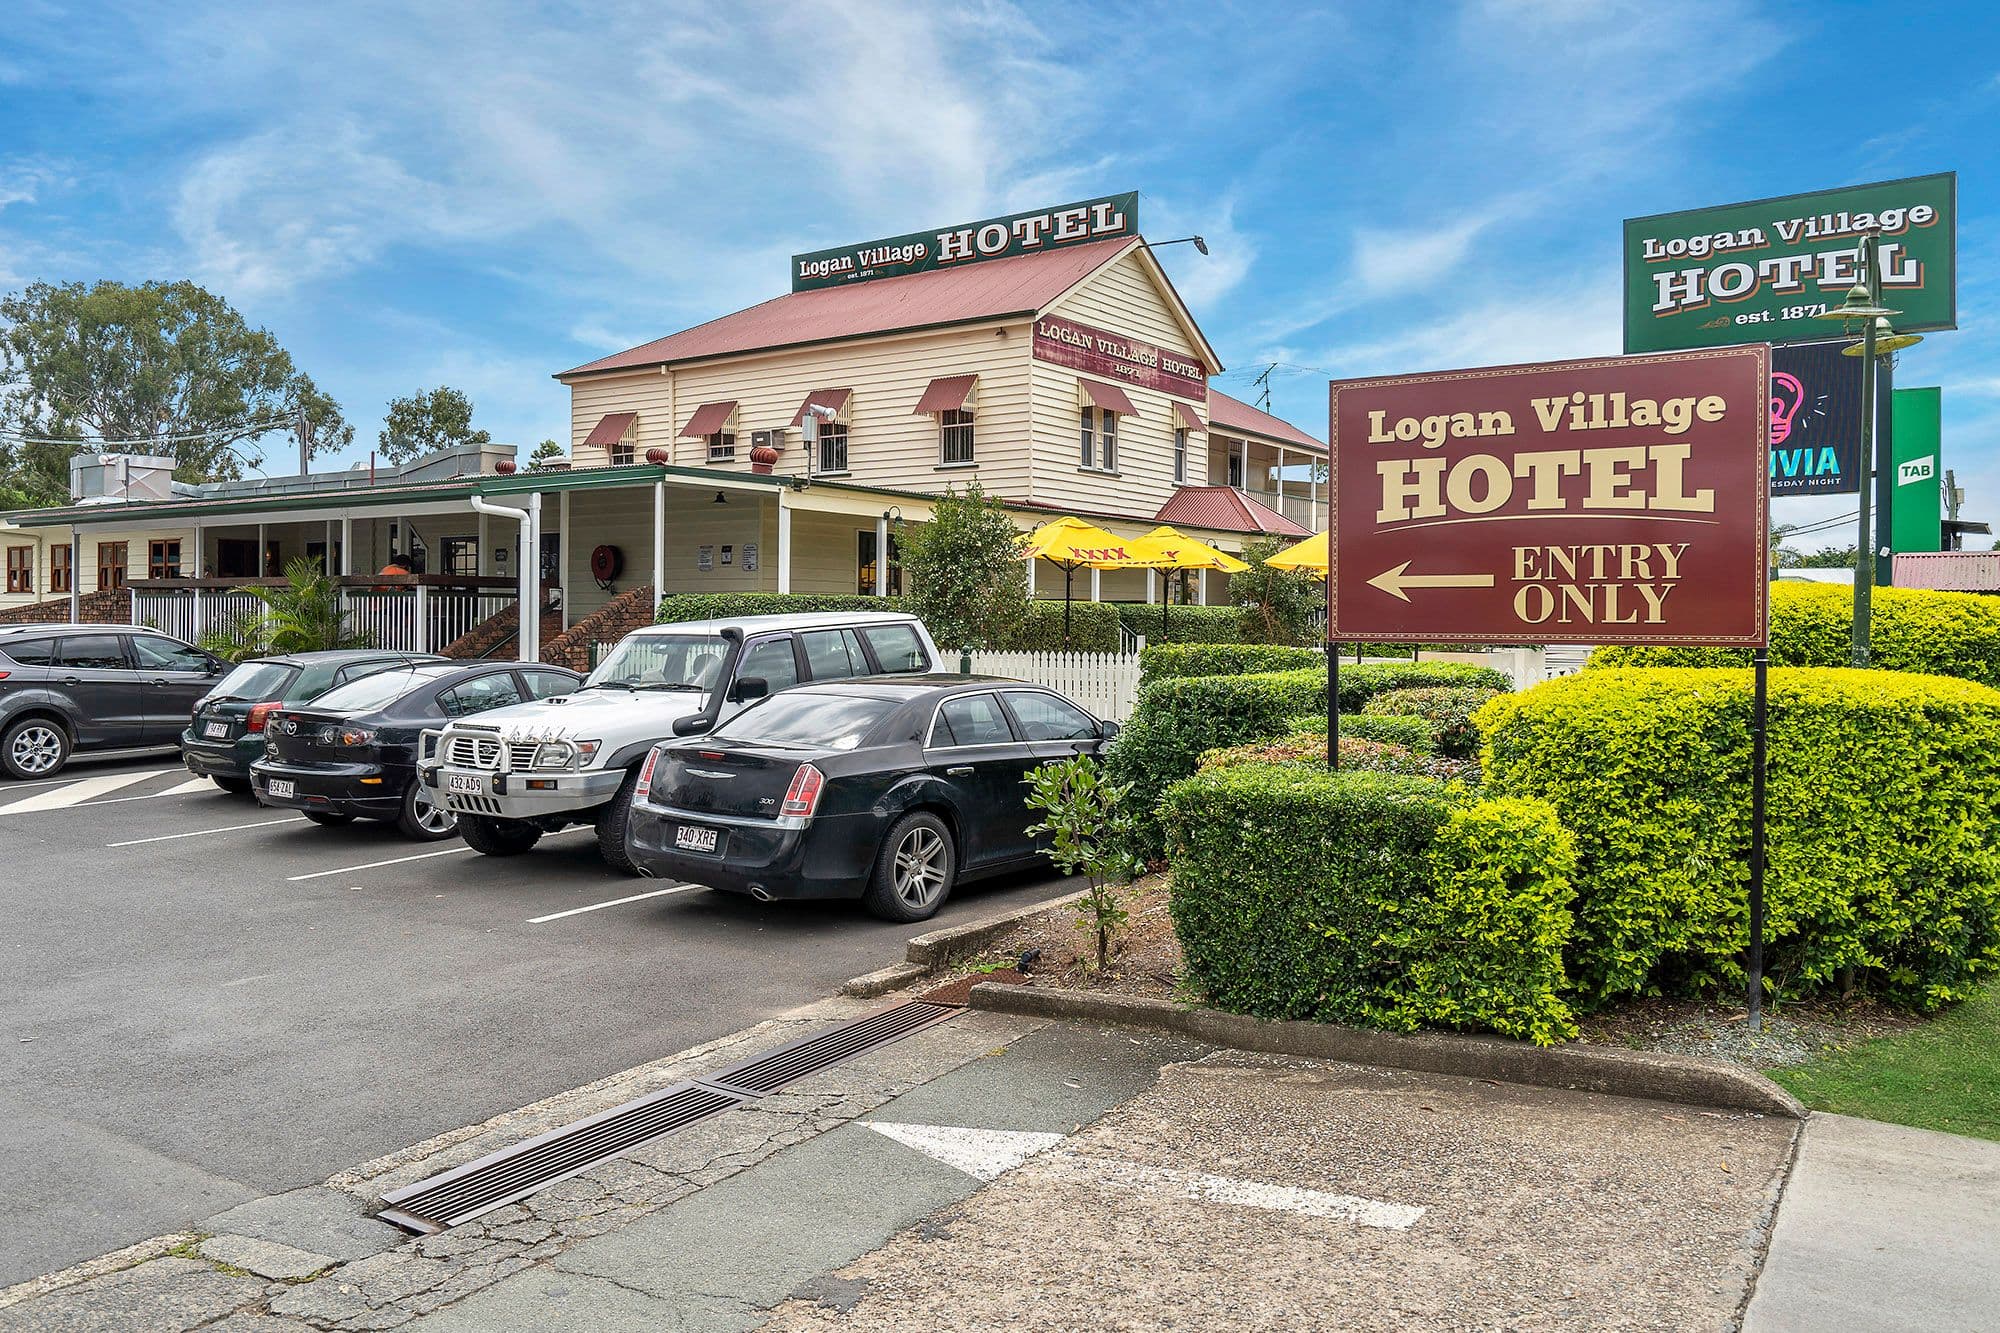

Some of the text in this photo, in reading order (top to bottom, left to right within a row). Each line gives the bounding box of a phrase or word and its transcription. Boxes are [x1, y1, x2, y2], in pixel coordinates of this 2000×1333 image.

[799, 202, 1126, 278] Logan Village HOTEL
[1643, 204, 1934, 260] Logan Village
[860, 269, 874, 278] 1871
[1652, 243, 1919, 313] HOTEL
[1734, 303, 1826, 326] est. 1871
[1039, 321, 1203, 380] LOGAN VILLAGE HOTEL
[1114, 364, 1141, 378] 1871
[1367, 391, 1727, 449] Logan Village
[1769, 446, 1841, 478] IVIA
[1901, 464, 1931, 478] TAB
[1376, 443, 1716, 525] HOTEL
[1771, 477, 1842, 488] ESDAY NIGHT
[1067, 546, 1131, 561] XXXX
[1511, 543, 1691, 581] ENTRY
[1513, 583, 1677, 625] ONLY
[758, 797, 775, 805] 300
